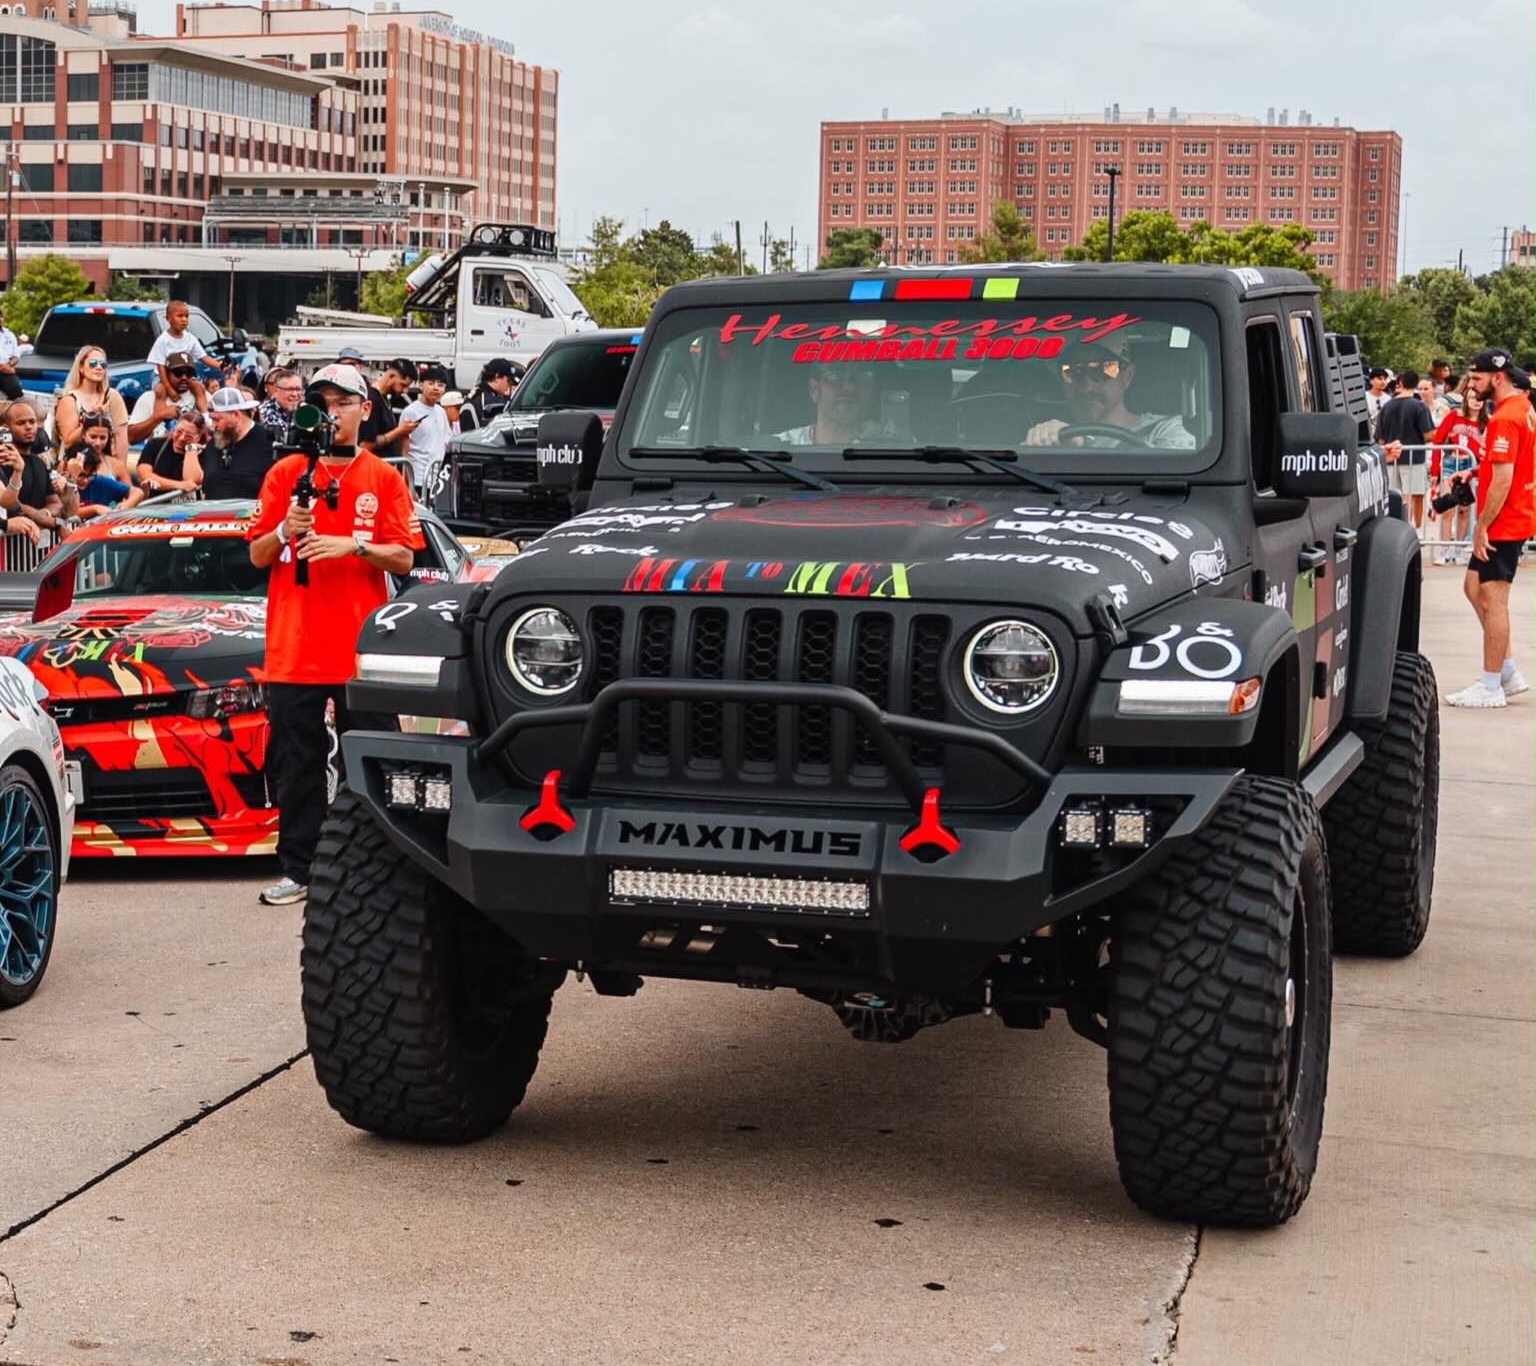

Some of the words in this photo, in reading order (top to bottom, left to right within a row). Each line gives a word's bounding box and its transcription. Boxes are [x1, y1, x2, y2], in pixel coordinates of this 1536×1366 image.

[719, 313, 1142, 344] Hennessey
[792, 338, 959, 363] GUMBALL
[966, 337, 1065, 359] 3000
[1281, 449, 1316, 477] mph
[1318, 449, 1348, 471] club
[409, 568, 430, 580] mph
[430, 569, 449, 582] club
[623, 557, 732, 592] MIA
[784, 561, 927, 598] MEX
[619, 820, 862, 857] MAXIMUS
